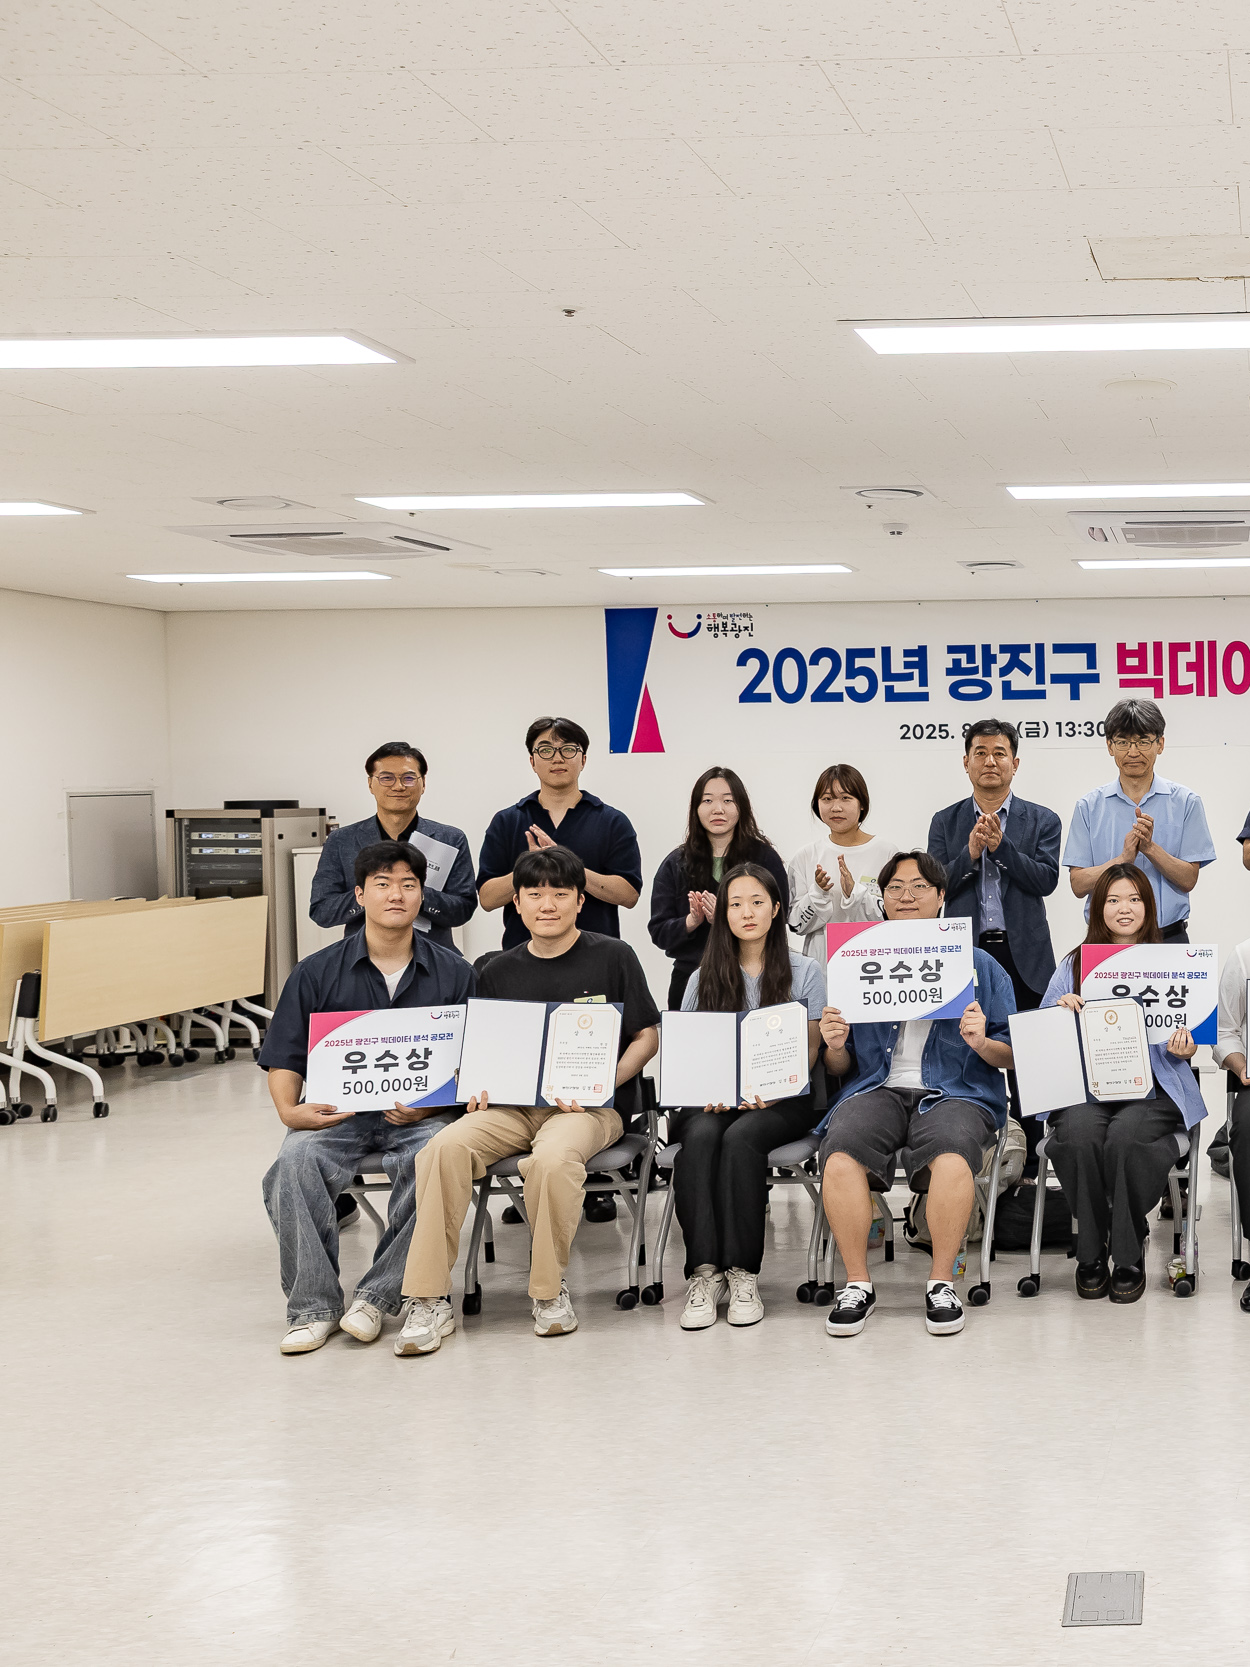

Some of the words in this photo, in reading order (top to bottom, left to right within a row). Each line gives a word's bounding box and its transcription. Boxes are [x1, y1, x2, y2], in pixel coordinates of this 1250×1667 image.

[706, 621, 753, 639] 행복광진
[736, 644, 930, 705] 2025년
[945, 642, 1100, 701] 광진구
[899, 723, 955, 740] 2025.
[1055, 720, 1106, 738] 13:30
[841, 949, 868, 957] 2025년
[869, 948, 892, 956] 광진구
[893, 946, 922, 955] 빅데이터
[924, 945, 939, 954] 분석
[940, 944, 962, 953] 공모전
[859, 959, 944, 985] 우수상
[1094, 971, 1119, 979] 2025년
[1120, 971, 1141, 979] 광진구
[1143, 971, 1170, 979] 빅데이터
[1171, 971, 1186, 979] 분석
[1187, 971, 1208, 979] 공모전
[863, 987, 943, 1006] 500,000원
[1145, 1013, 1187, 1029] 000원
[324, 1039, 353, 1048] 2025년
[355, 1037, 379, 1046] 광진구
[380, 1035, 412, 1045] 빅데이터
[413, 1034, 429, 1043] 분석
[430, 1032, 454, 1042] 공모전
[342, 1047, 433, 1074] 우수상
[342, 1075, 429, 1095] 500,000원
